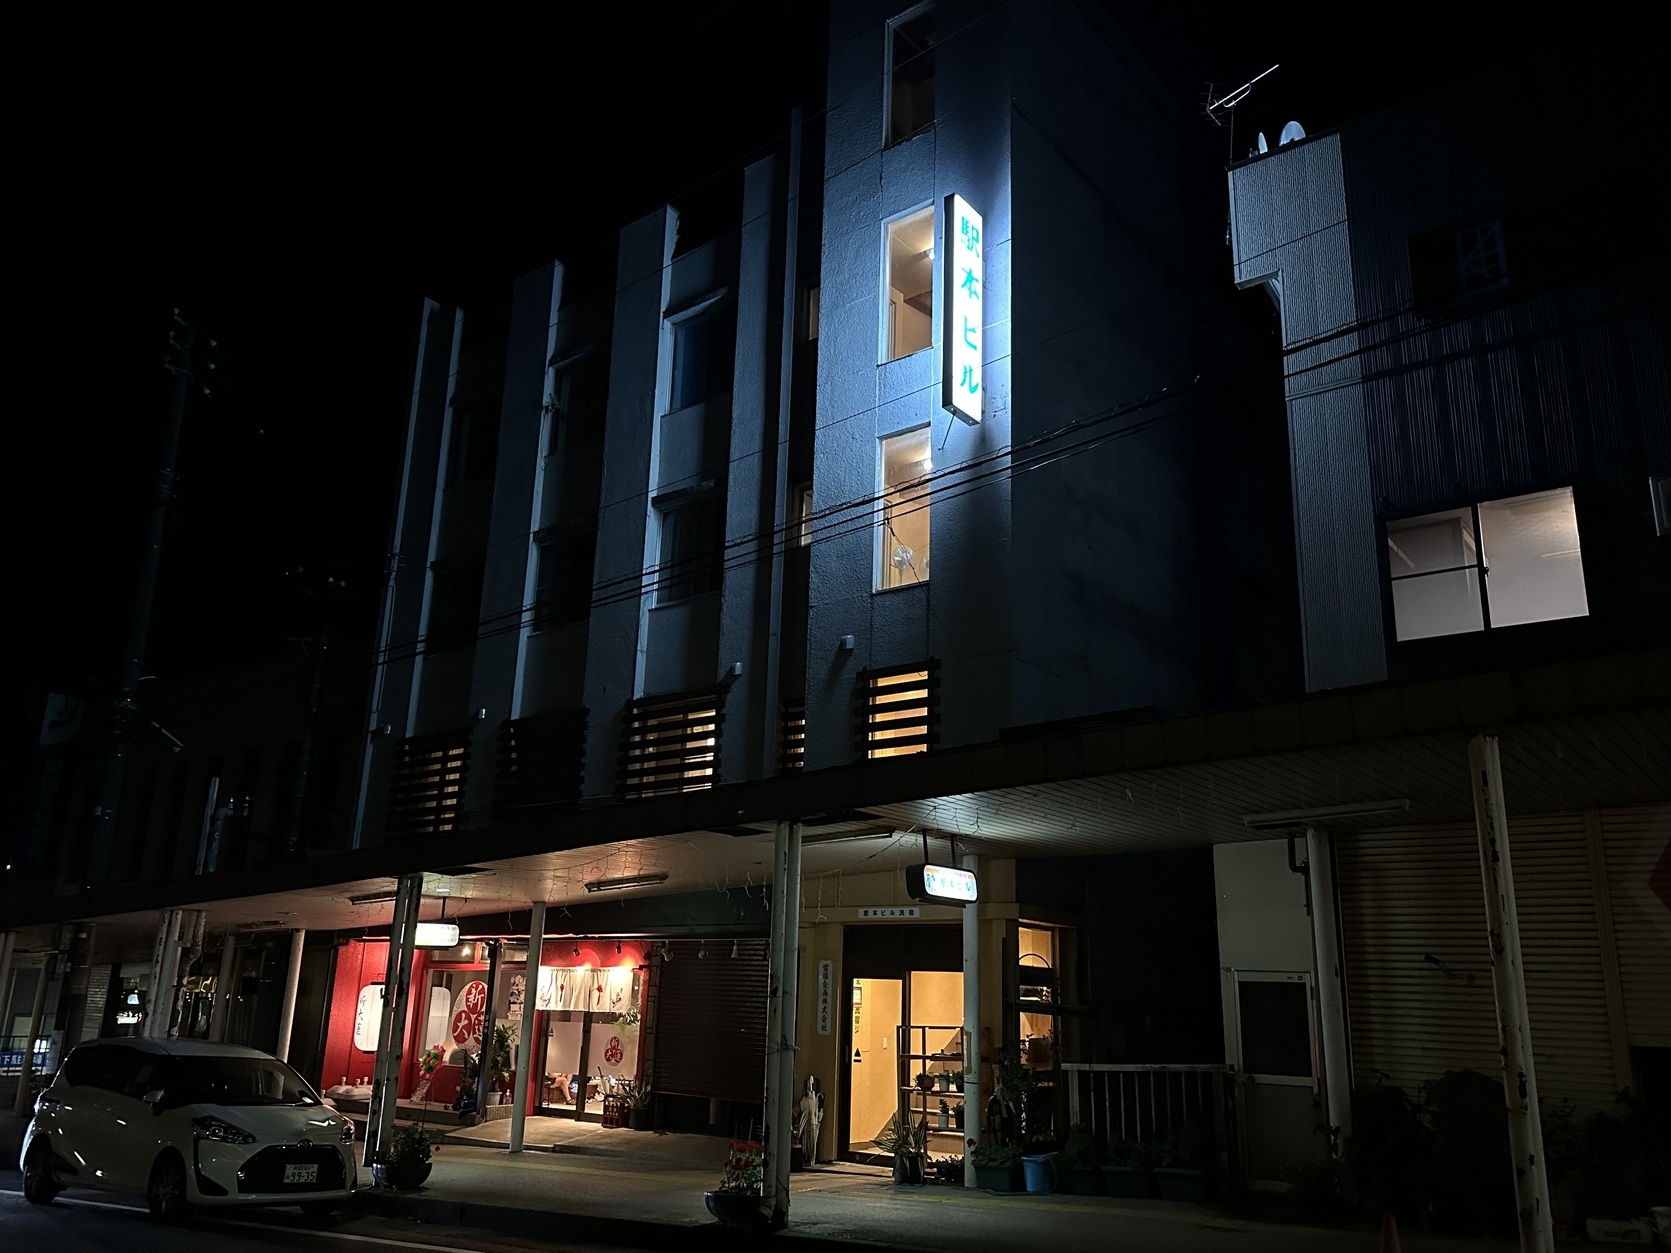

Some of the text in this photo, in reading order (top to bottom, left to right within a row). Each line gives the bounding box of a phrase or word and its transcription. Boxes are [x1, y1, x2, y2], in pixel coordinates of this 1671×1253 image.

[863, 908, 915, 918] 駅本ビル民宿
[821, 963, 830, 1032] 雪国企画株式会社
[290, 1171, 316, 1183] 99-35
